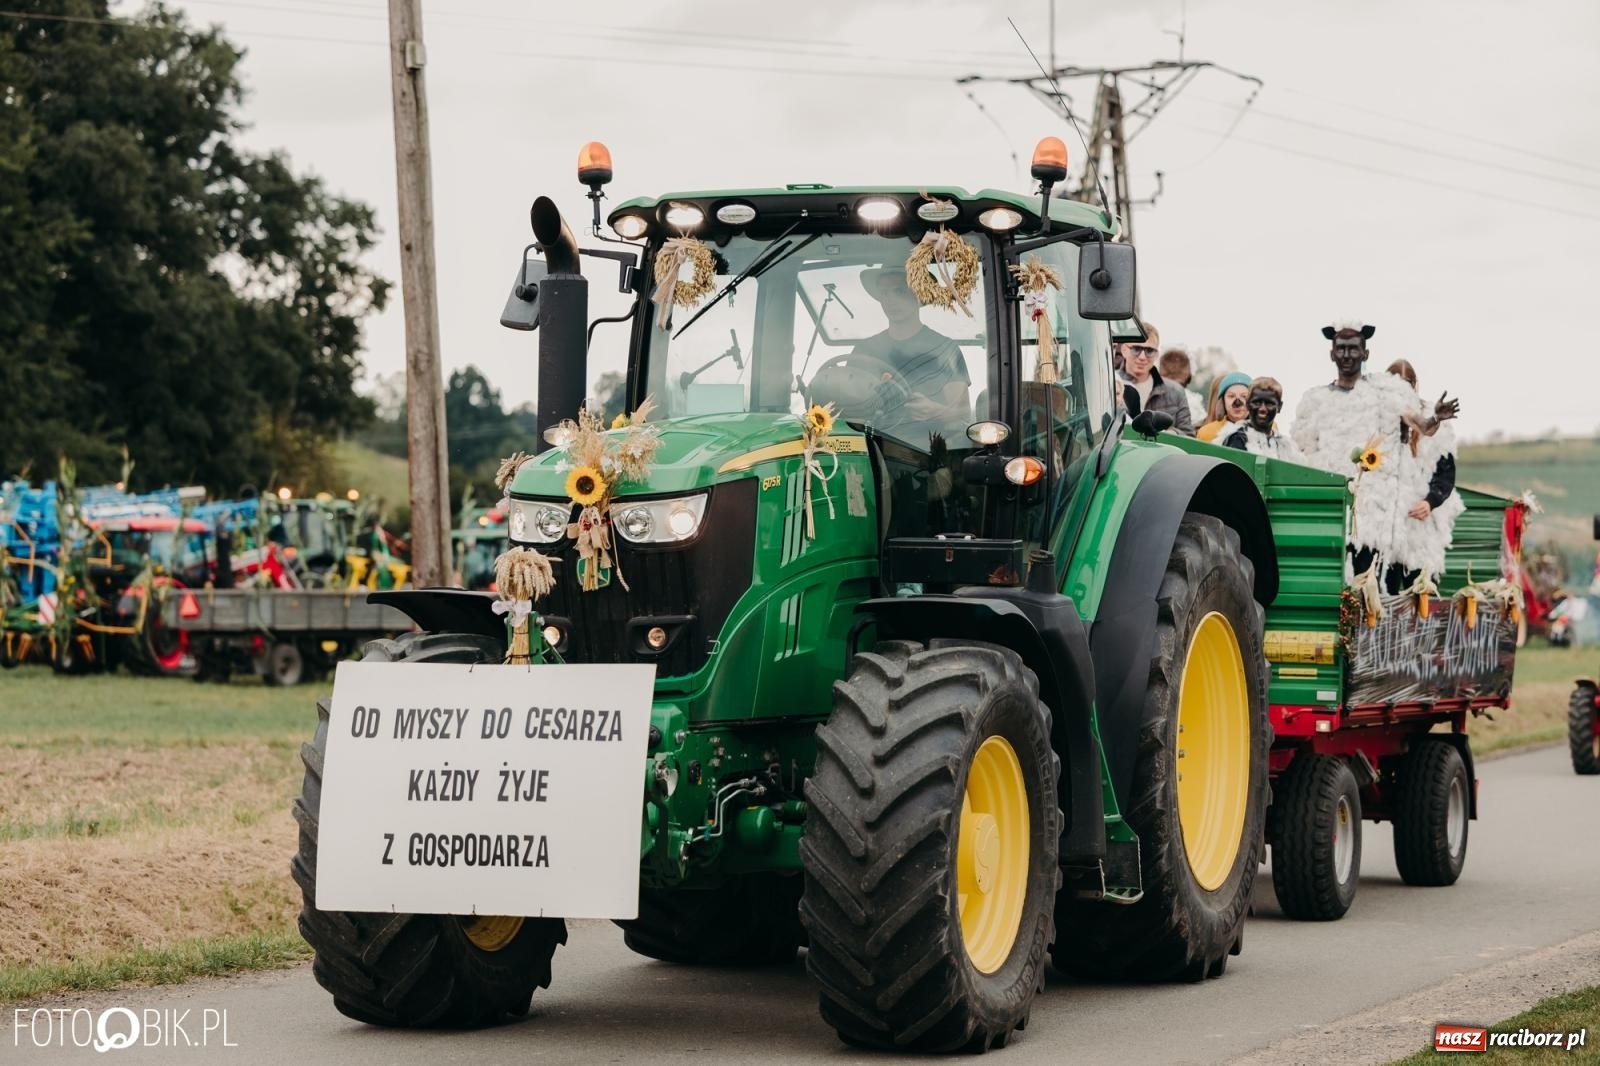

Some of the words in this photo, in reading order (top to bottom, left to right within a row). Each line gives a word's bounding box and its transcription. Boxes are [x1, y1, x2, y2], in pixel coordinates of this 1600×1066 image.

[351, 705, 381, 739] OD
[393, 707, 469, 740] MYSZY
[481, 707, 513, 740] DO
[525, 706, 623, 742] CESARZA
[408, 761, 480, 802] KAŻDY
[497, 761, 549, 803] ŻYJE
[382, 832, 395, 866] Z
[408, 832, 550, 868] GOSPODARZA
